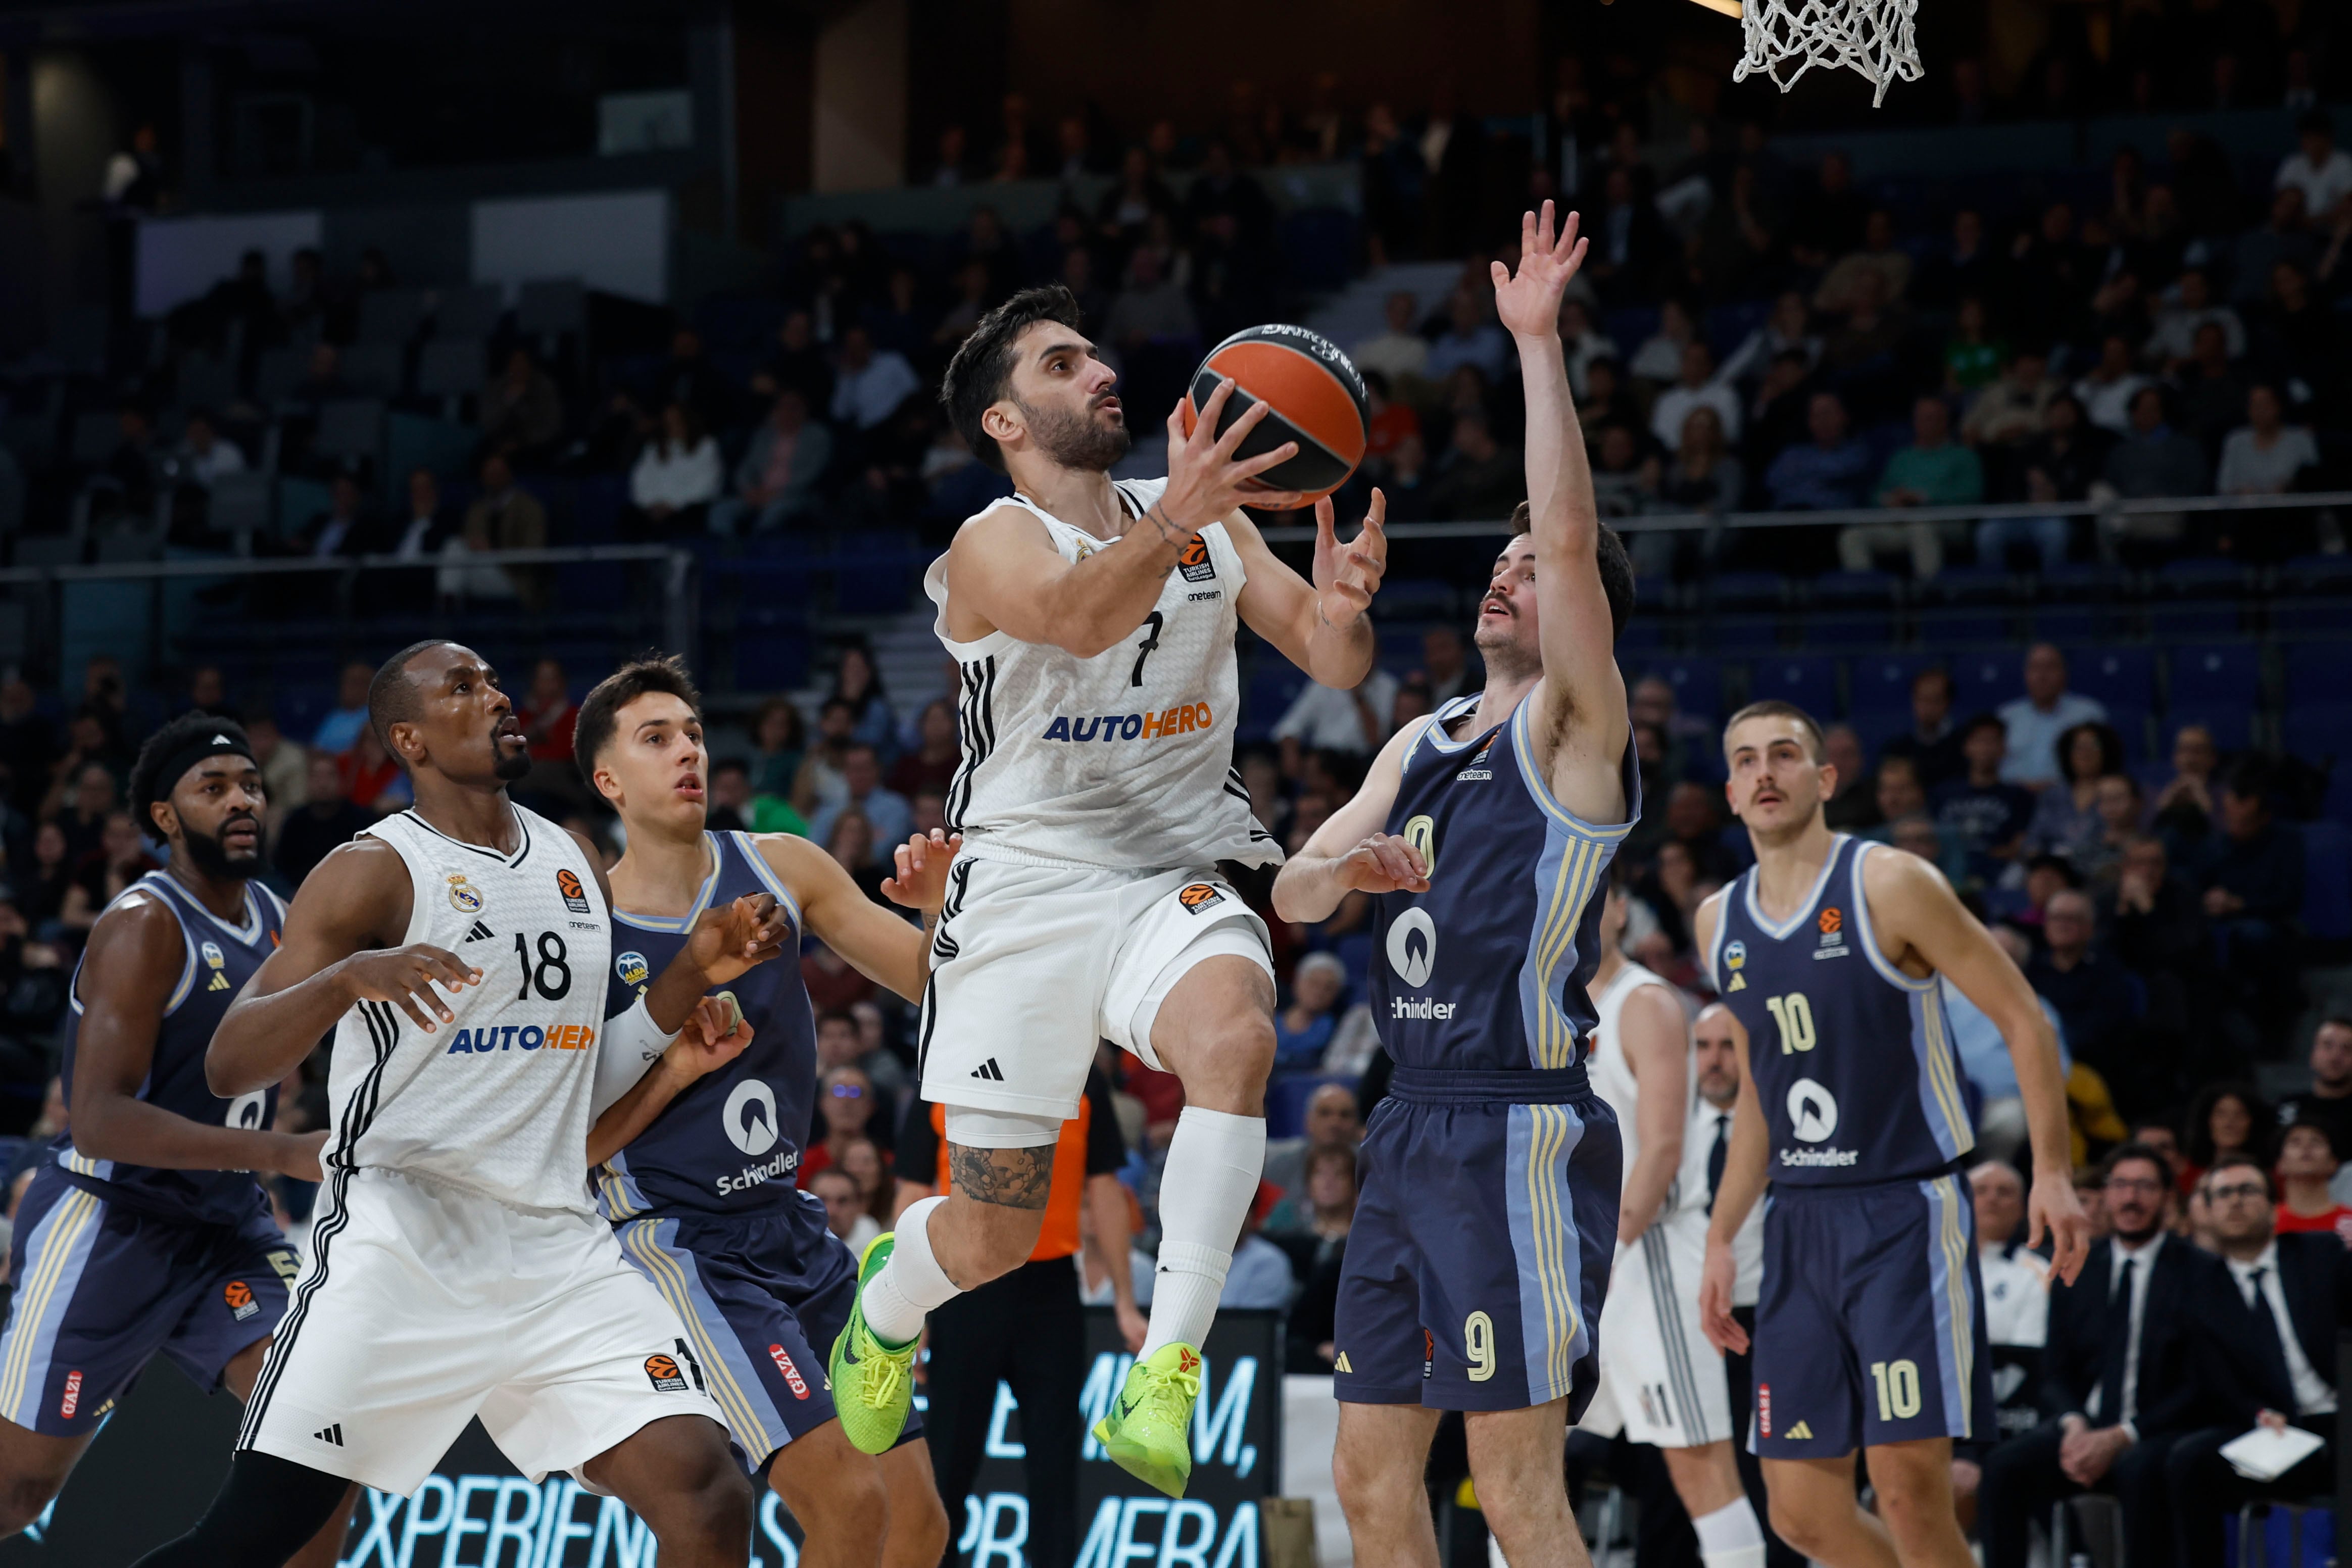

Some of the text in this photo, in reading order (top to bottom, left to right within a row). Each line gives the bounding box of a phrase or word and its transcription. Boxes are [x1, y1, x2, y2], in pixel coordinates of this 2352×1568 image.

[1183, 562, 1210, 573] TURKISH
[1186, 567, 1212, 578] AIRLINES
[1188, 591, 1221, 602] oneteam
[1132, 611, 1163, 687] 7
[1042, 702, 1212, 742] AUTOHERO
[569, 921, 601, 930] oneteam
[514, 931, 571, 1001] 18
[625, 966, 647, 982] ALBA
[447, 1025, 595, 1054] AUTOHER
[1766, 991, 1817, 1055] 10
[716, 1150, 799, 1197] Schindler
[1779, 1146, 1859, 1167] Schindler
[266, 1250, 304, 1294] 5
[1464, 1310, 1496, 1382] 9
[770, 1347, 808, 1394] GAZI
[1870, 1359, 1922, 1422] 10
[62, 1375, 82, 1415] GAZI
